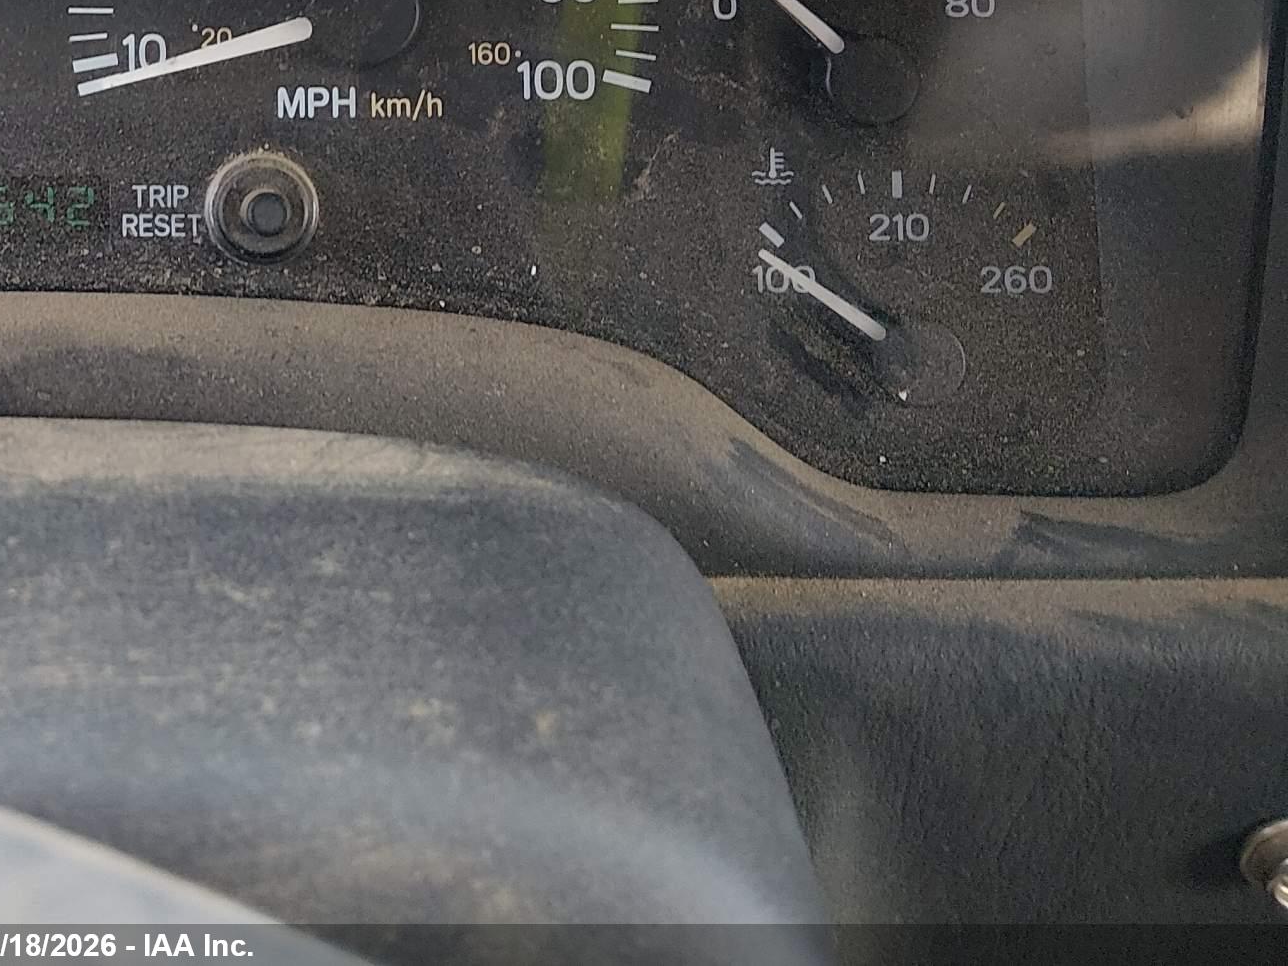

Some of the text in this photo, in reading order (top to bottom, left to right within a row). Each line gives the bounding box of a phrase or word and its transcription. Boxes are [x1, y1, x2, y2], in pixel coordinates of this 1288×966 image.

[122, 33, 167, 71] 10
[201, 27, 233, 49] 20
[467, 43, 511, 66] 160
[516, 60, 597, 101] 100
[276, 87, 444, 119] MPH km/h
[132, 184, 189, 208] TRIP
[122, 214, 202, 238] RESET
[868, 213, 931, 242] 210
[752, 265, 816, 294] 100
[980, 266, 1053, 295] 260
